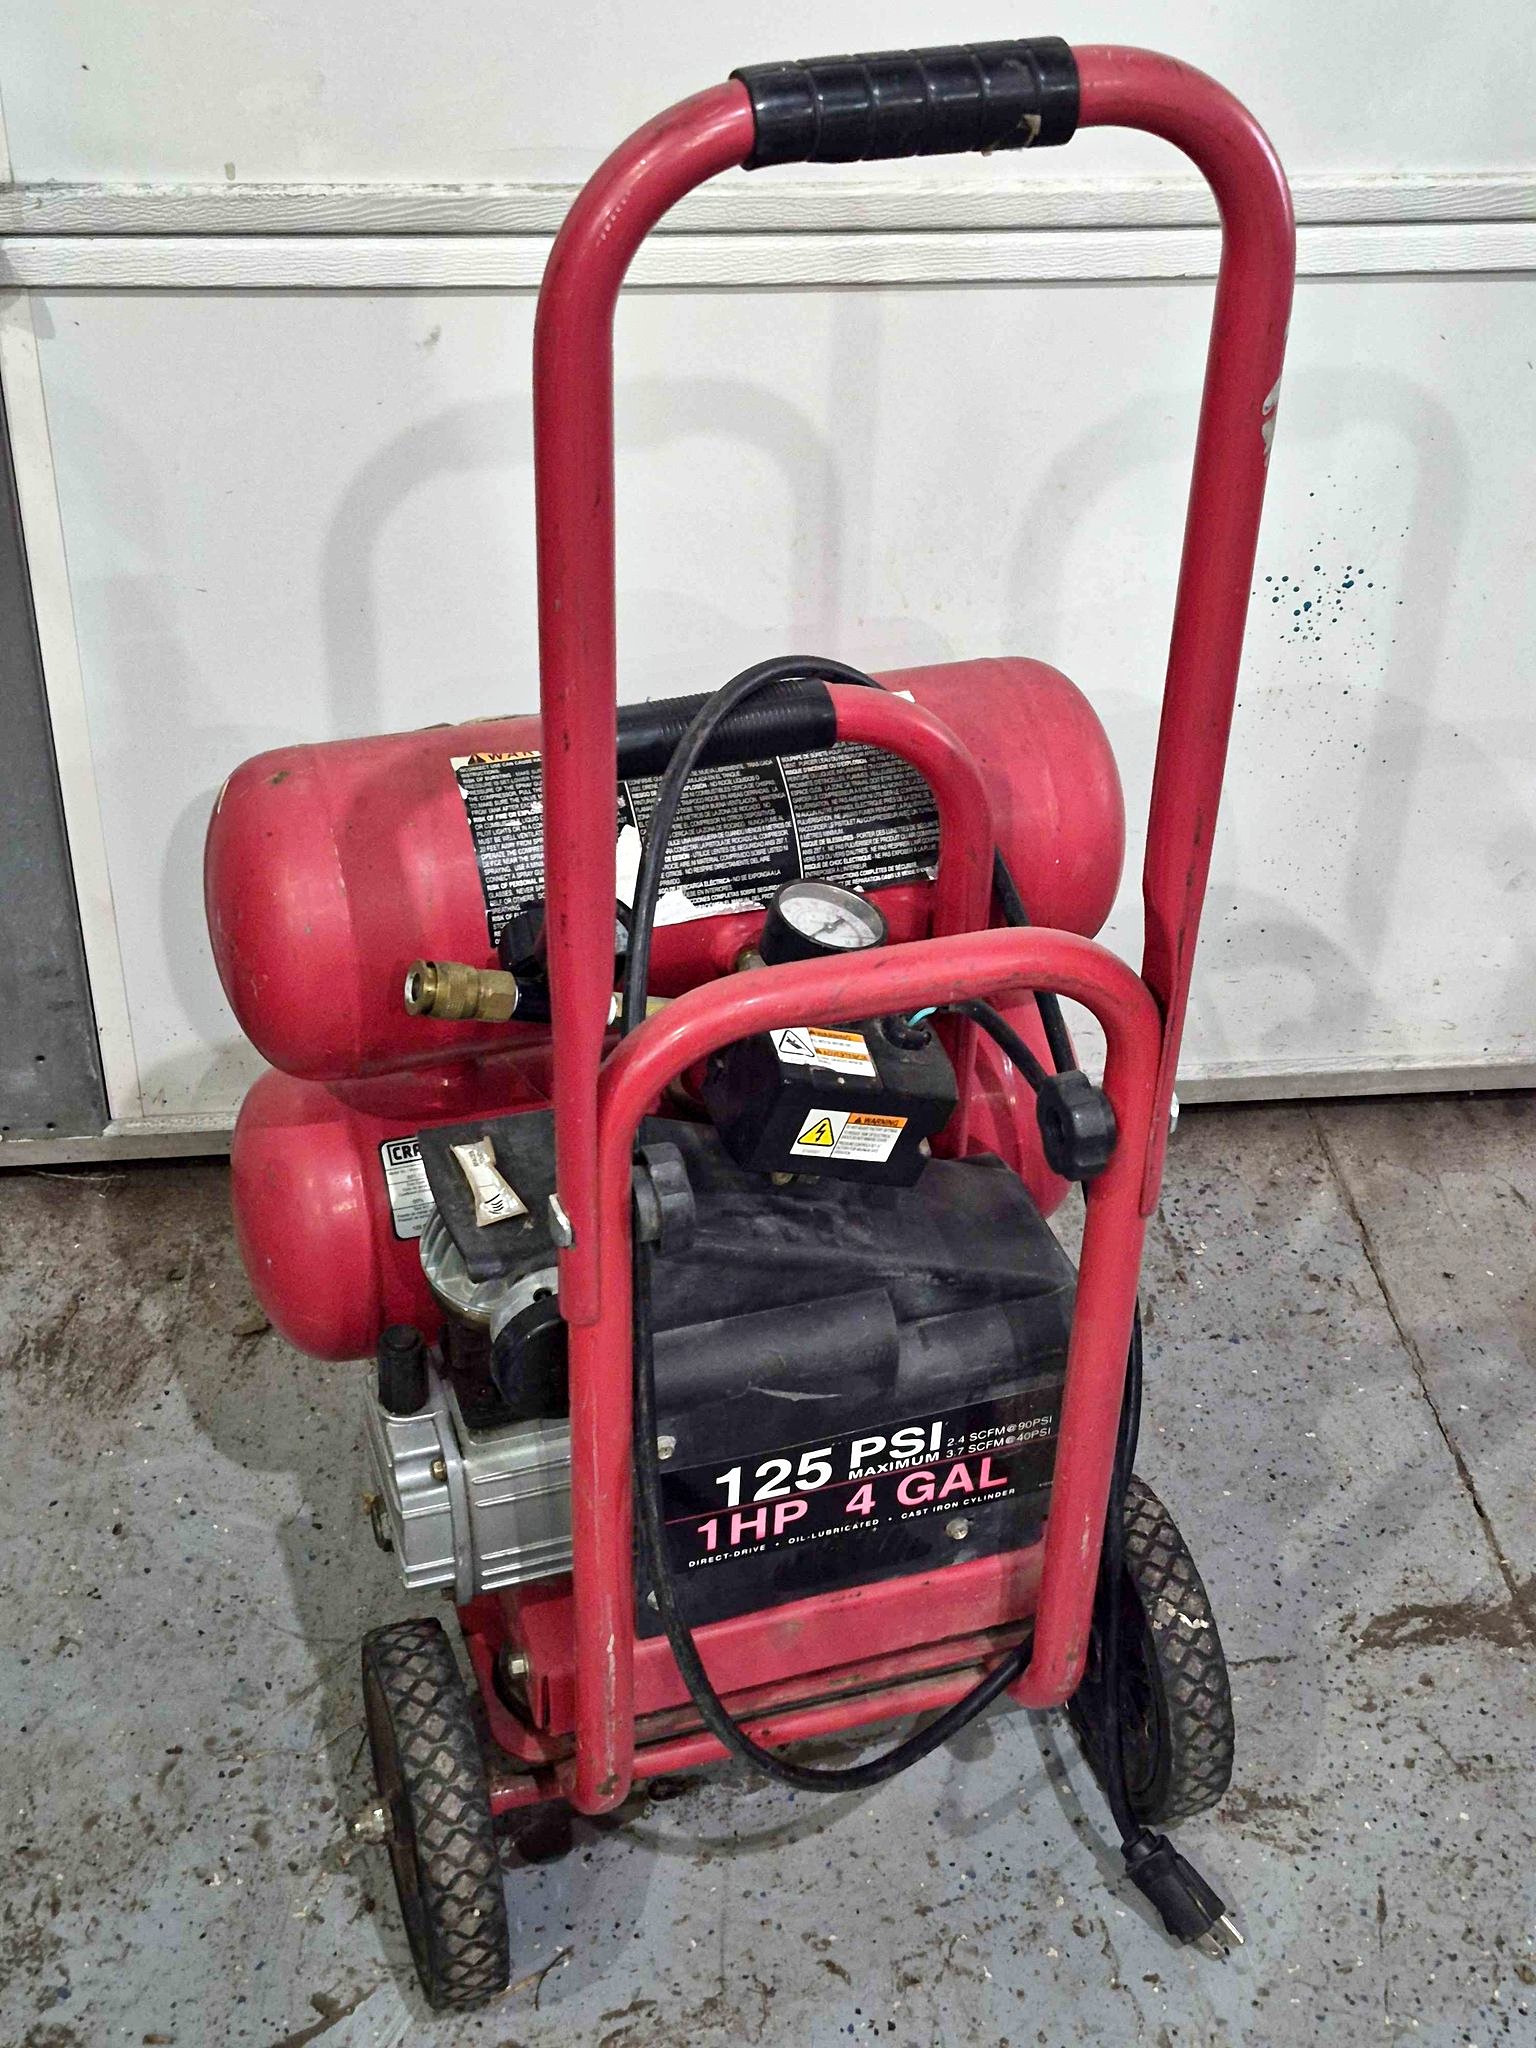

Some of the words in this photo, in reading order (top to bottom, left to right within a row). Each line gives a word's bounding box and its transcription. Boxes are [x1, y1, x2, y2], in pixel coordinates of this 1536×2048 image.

[863, 1117, 898, 1127] WARNING
[945, 1447, 965, 1459] 3.7
[946, 1435, 966, 1447] 2.4
[715, 1447, 833, 1508] 125
[849, 1421, 943, 1469] PSI
[848, 1452, 940, 1481] MAXIMUM
[697, 1499, 808, 1551] 1HP
[845, 1483, 876, 1515] 4
[896, 1457, 1008, 1506] GAL
[688, 1543, 767, 1568] DIRECT-DRIVE
[788, 1519, 879, 1544] OIL-LUBRICATED
[901, 1505, 930, 1520] CAST
[932, 1501, 960, 1514] IRON
[963, 1488, 1016, 1506] CYLINDER
